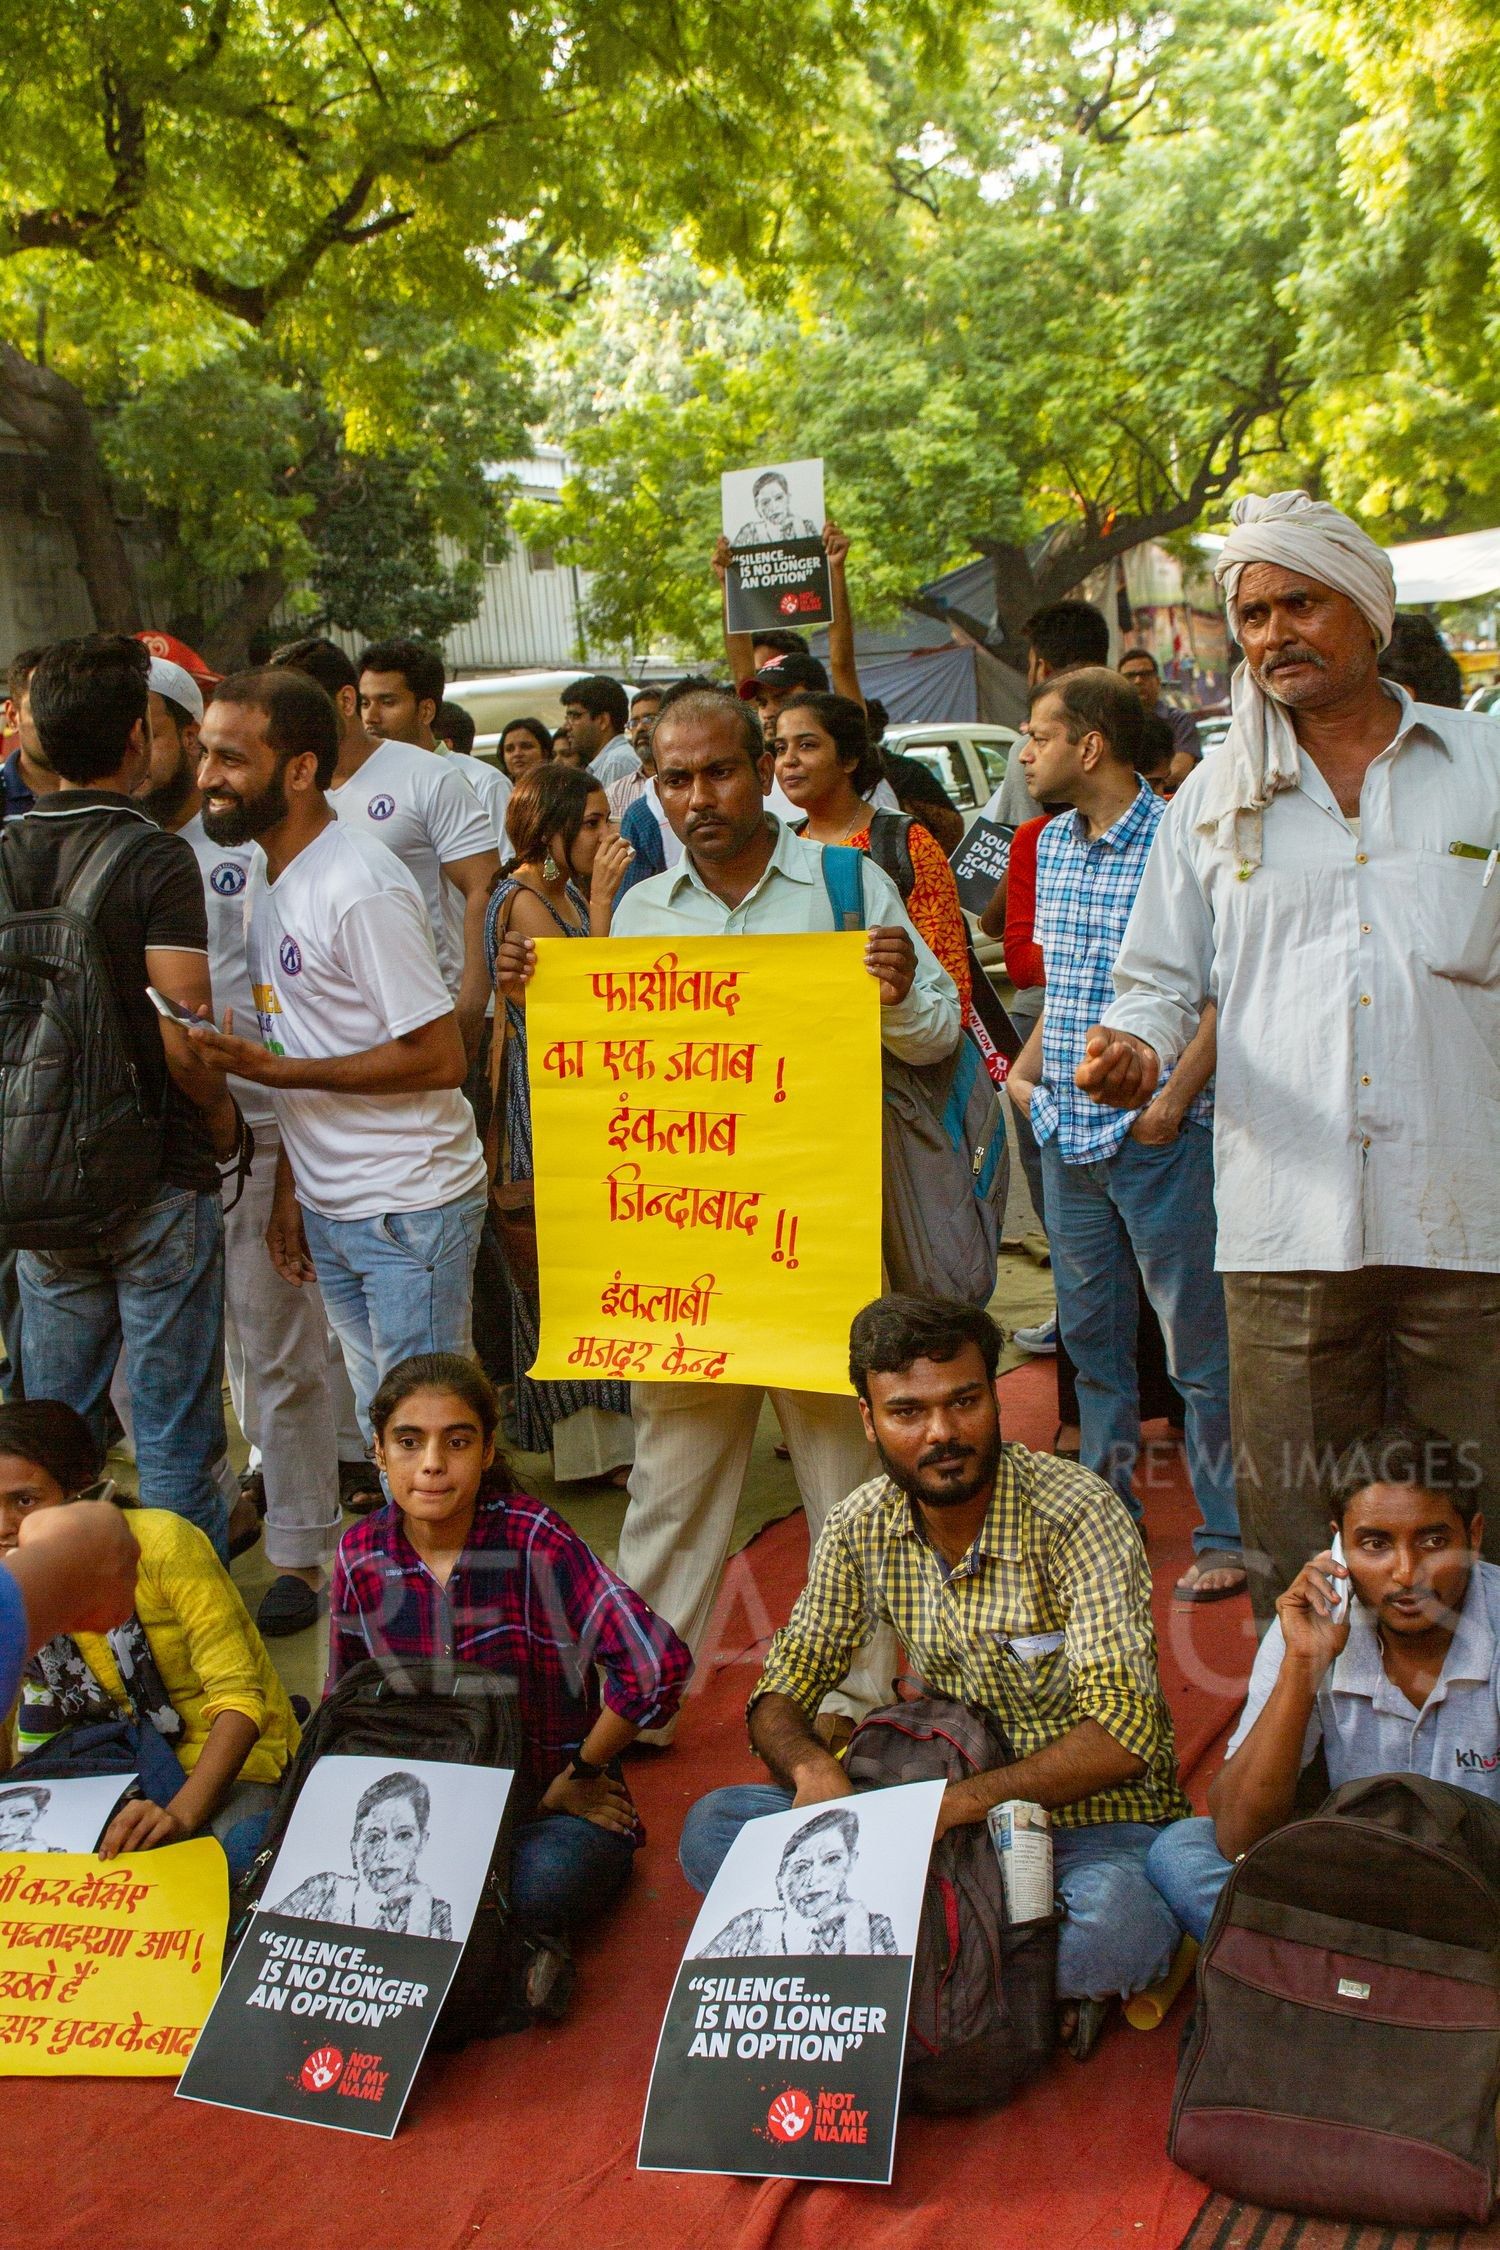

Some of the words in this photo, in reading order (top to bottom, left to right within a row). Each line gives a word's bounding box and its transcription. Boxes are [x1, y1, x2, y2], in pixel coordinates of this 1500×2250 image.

[740, 565, 752, 578] IS
[753, 563, 772, 577] NO
[774, 557, 821, 574] LONGER
[741, 577, 760, 589] AN
[970, 841, 992, 857] DO
[956, 863, 976, 880] US
[962, 852, 1004, 880] SCARE
[585, 952, 749, 1016] फासीवाद
[976, 1029, 992, 1050] NOT
[543, 1040, 588, 1079] का
[596, 1039, 656, 1081] एक
[608, 1092, 748, 1156] इंकलाब
[600, 1270, 723, 1326] इंकलाबी
[567, 1335, 662, 1377] मजदूर
[258, 1958, 282, 1983] IS
[285, 1964, 327, 1990] NO
[328, 1971, 429, 2008] LONGER
[246, 1984, 290, 2012] AN
[290, 1991, 403, 2028] OPTION”
[694, 2004, 719, 2029] IS
[724, 2004, 768, 2029] NO
[773, 2005, 887, 2034] LONGER
[687, 2032, 731, 2058] AN
[736, 2033, 863, 2062] OPTION”
[348, 2051, 382, 2070] NOT
[343, 2066, 363, 2084] IN
[363, 2070, 390, 2086] MY
[336, 2081, 386, 2102] NAME
[817, 2092, 855, 2110] NOT
[816, 2110, 836, 2127] IN
[839, 2110, 868, 2127] MY
[814, 2126, 868, 2144] NAME
